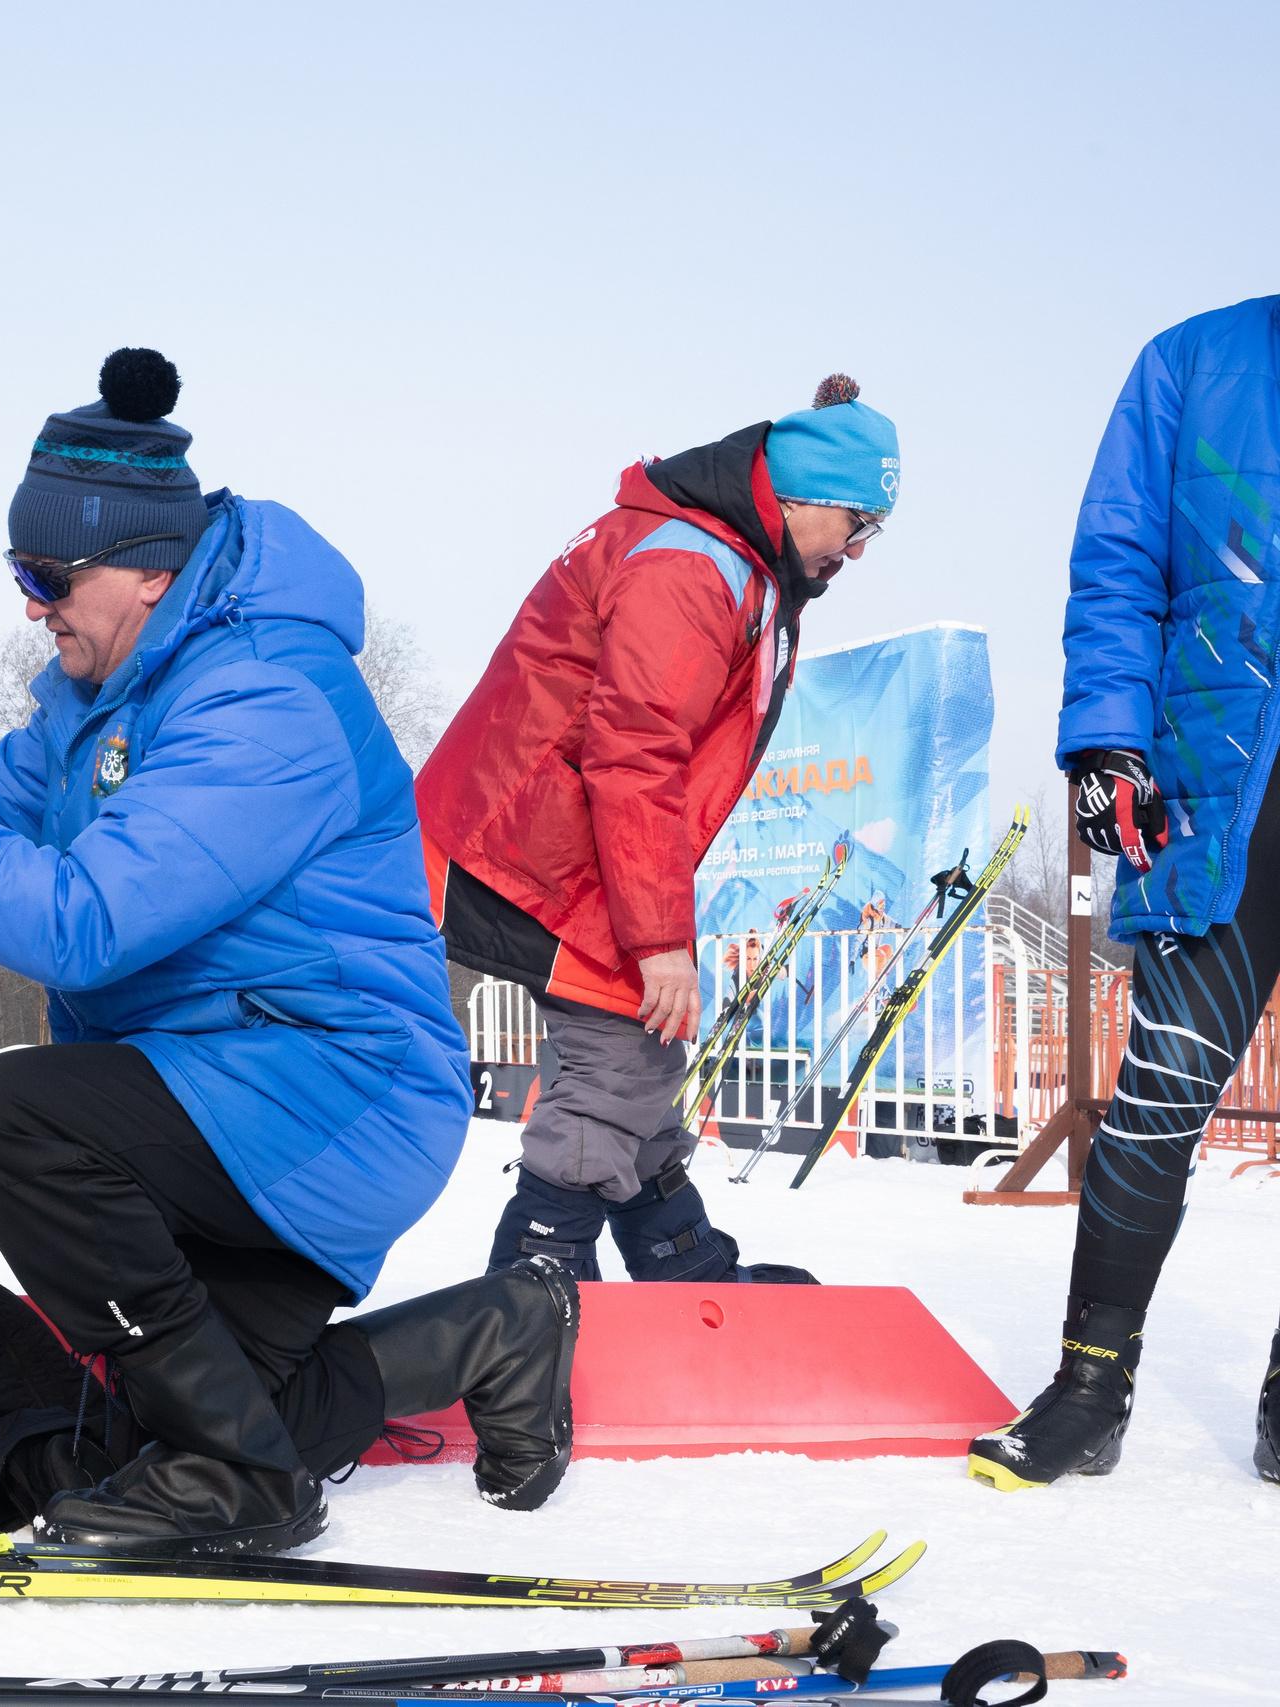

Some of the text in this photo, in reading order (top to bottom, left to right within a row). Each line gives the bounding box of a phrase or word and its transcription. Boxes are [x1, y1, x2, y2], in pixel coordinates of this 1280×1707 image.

[777, 744, 820, 760] ЗИМНЯЯ
[751, 808, 778, 821] 2025
[779, 805, 807, 820] ГОДА
[976, 829, 1016, 888] FISCHER
[984, 831, 1024, 890] FISCHER
[712, 867, 764, 880] УДМУРТСКАЯ
[766, 864, 820, 877] РЕСПУБЛИКА
[1077, 891, 1091, 902] 2
[479, 1071, 493, 1110] 2
[486, 1576, 794, 1593] FISCHER
[527, 1589, 834, 1605] FISCHER
